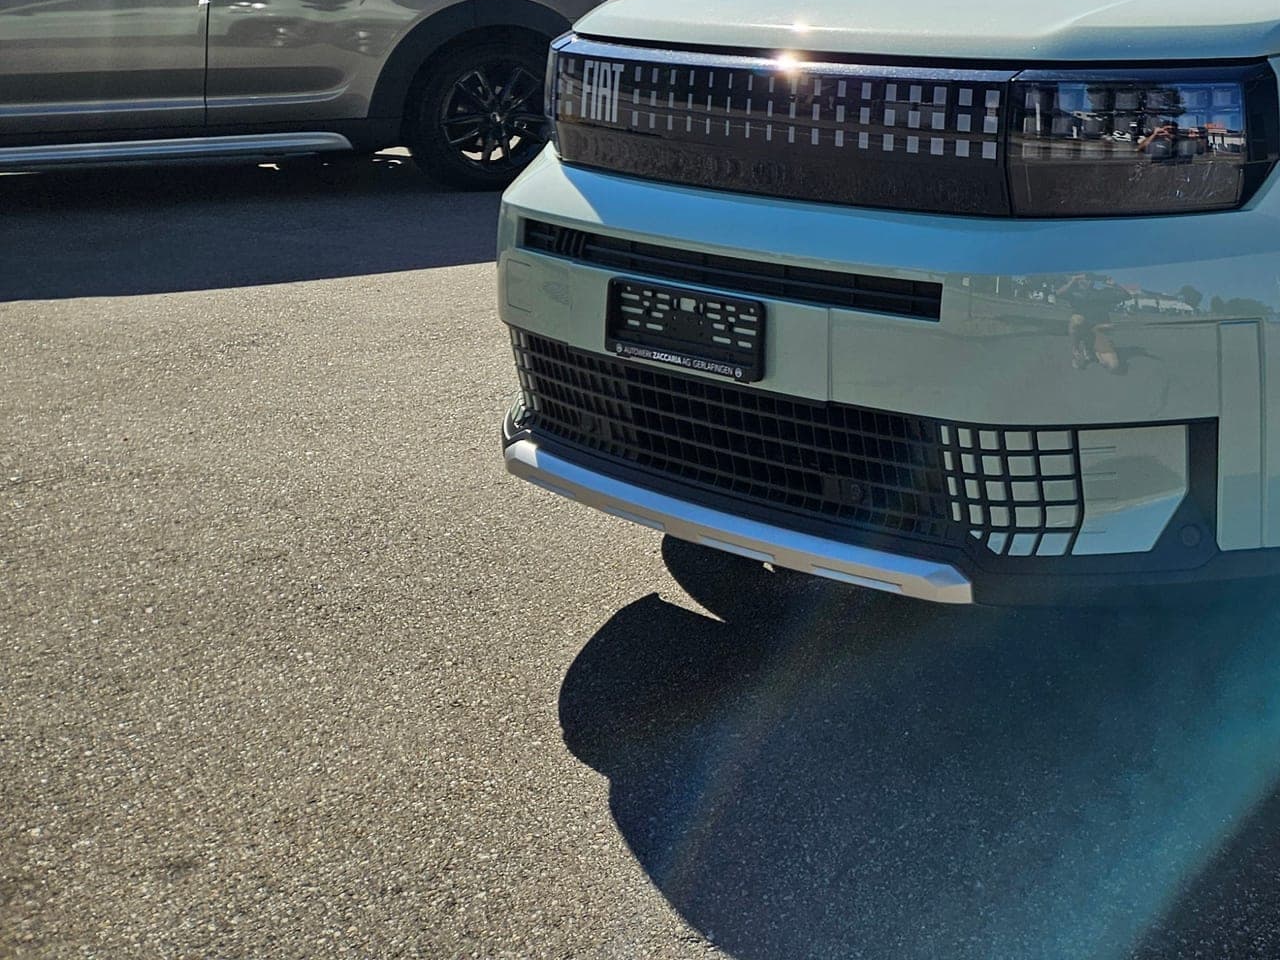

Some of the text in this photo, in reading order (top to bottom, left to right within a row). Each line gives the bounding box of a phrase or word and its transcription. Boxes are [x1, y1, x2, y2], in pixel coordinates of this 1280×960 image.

[580, 59, 625, 125] FIAT
[652, 351, 682, 365] ZACCARIA
[681, 358, 692, 367] AG
[692, 358, 734, 376] GERLAFINGEN
